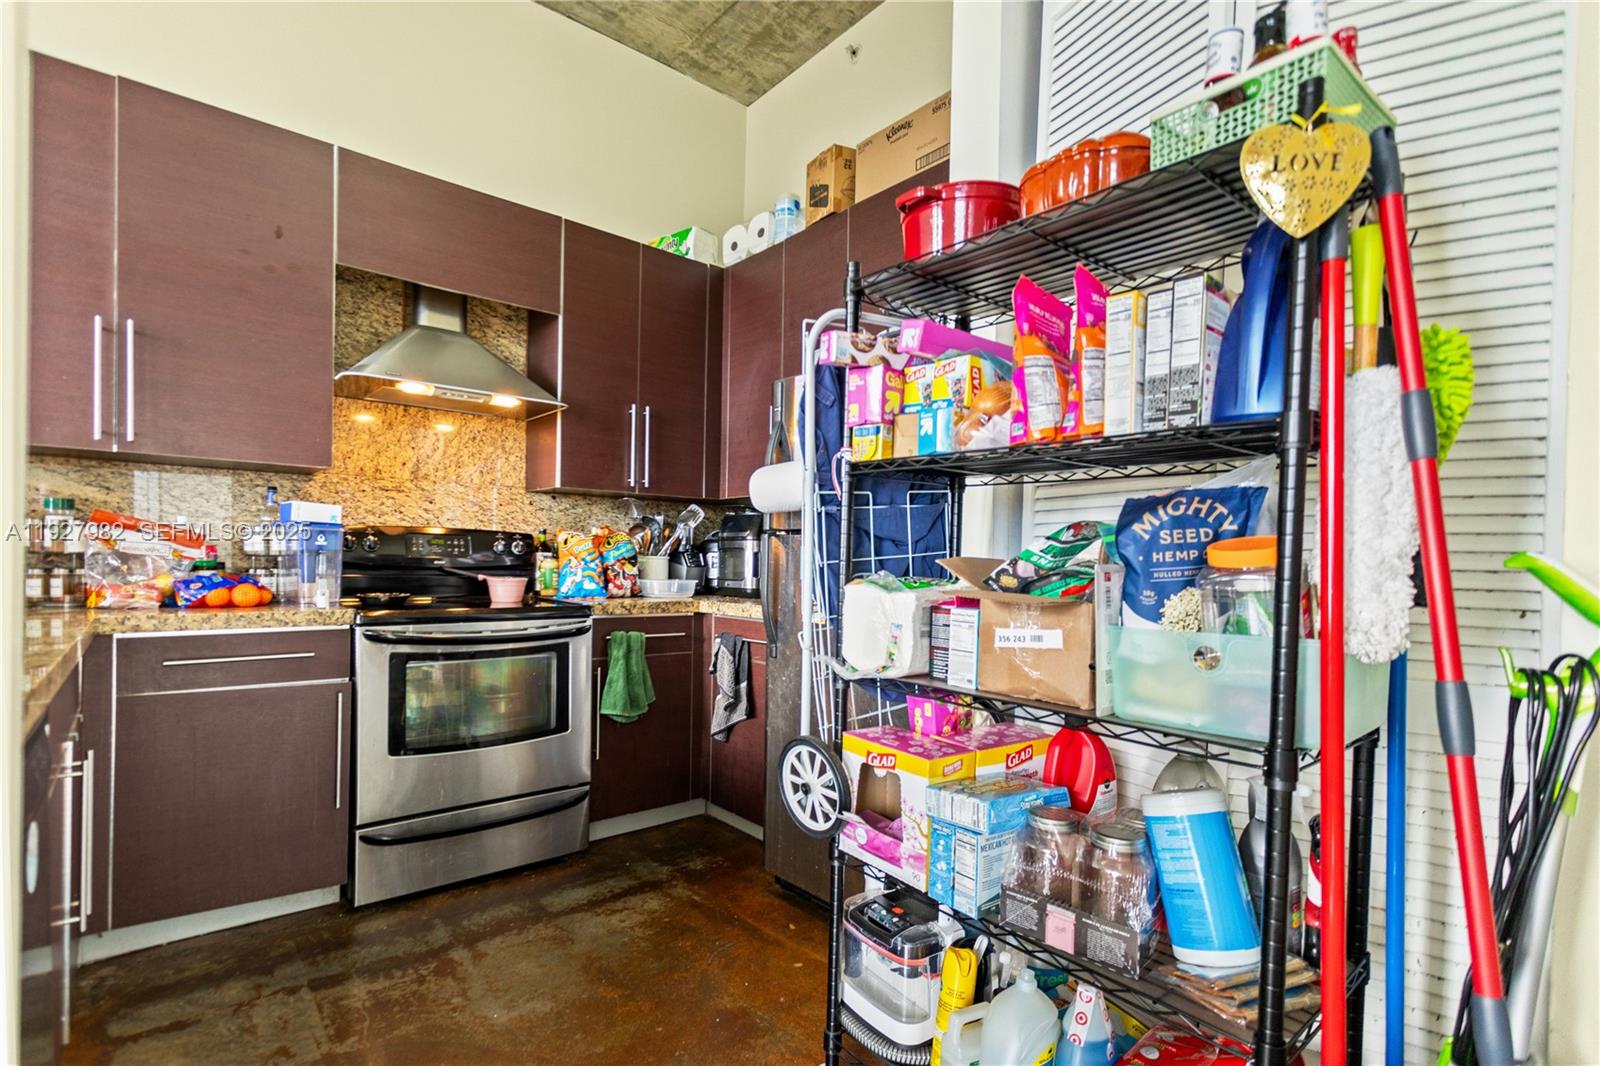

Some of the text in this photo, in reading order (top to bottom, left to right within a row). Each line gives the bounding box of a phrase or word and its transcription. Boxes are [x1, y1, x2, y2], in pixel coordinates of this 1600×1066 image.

[1272, 152, 1343, 173] LOVE
[906, 367, 926, 383] GLAD
[935, 360, 957, 377] GLAD
[972, 368, 981, 397] LAD
[1131, 496, 1239, 541] MIGHTY
[1159, 527, 1213, 545] SEED
[1152, 549, 1199, 563] HEMP
[1153, 570, 1182, 579] HULLED
[998, 635, 1026, 643] 356 243
[867, 753, 896, 768] GLAD
[1007, 747, 1032, 767] GLAD
[980, 840, 1002, 852] MEXICAN
